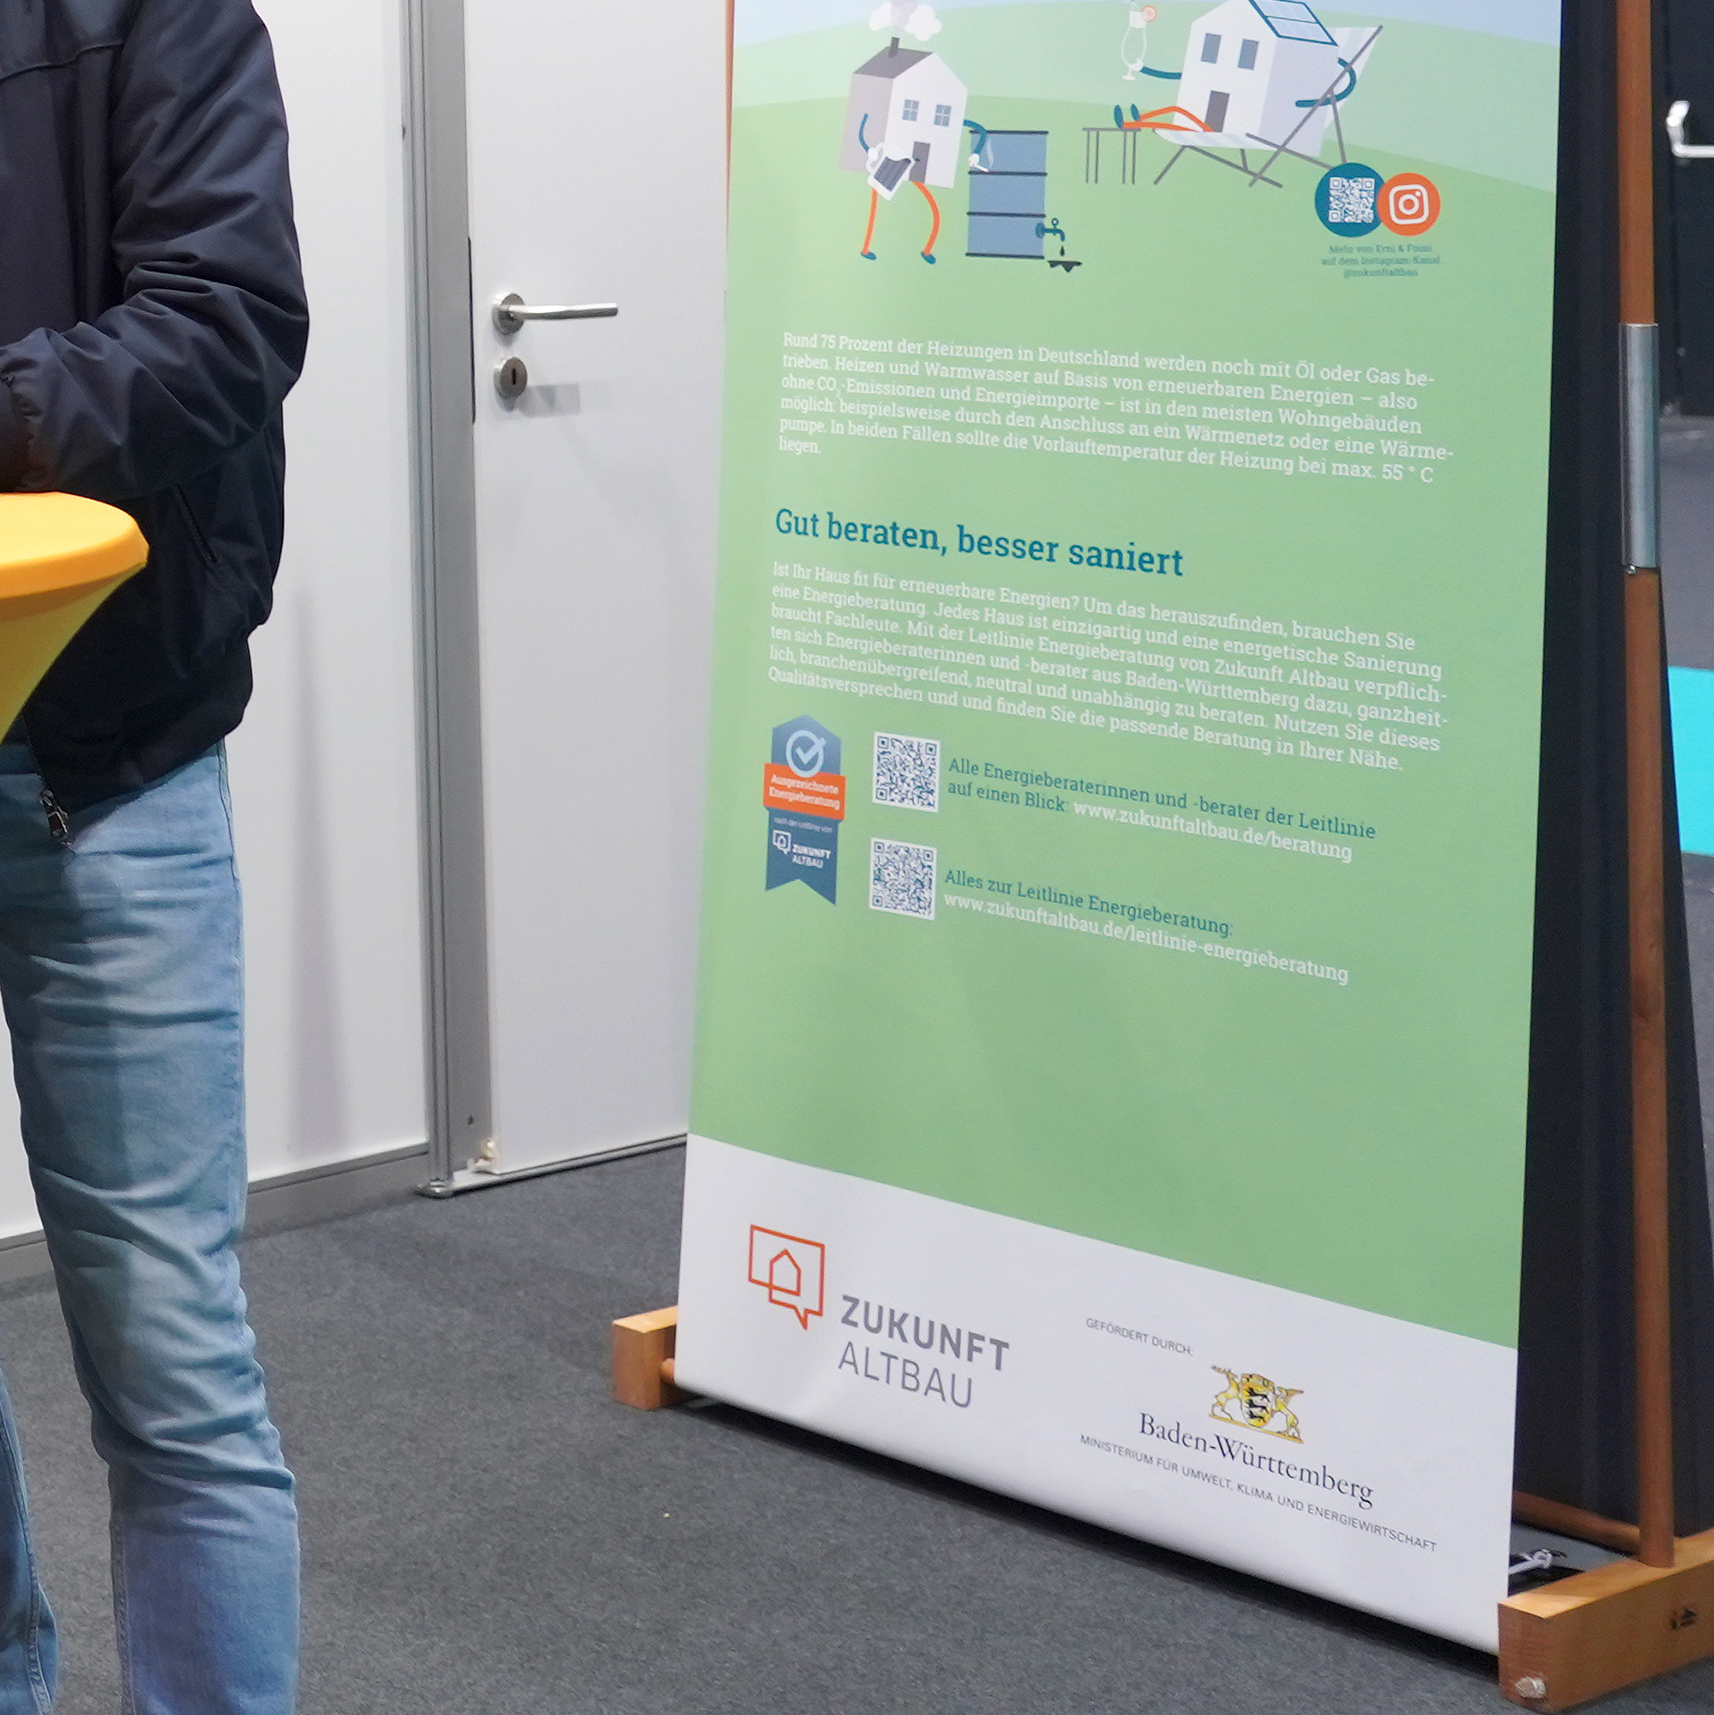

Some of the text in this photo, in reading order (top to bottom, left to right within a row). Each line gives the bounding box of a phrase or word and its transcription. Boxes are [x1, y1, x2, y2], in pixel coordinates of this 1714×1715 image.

[775, 508, 1183, 576] Gut beraten, besser saniert
[794, 630, 823, 645] sich
[825, 633, 986, 666] Energieberaterinnen
[989, 656, 1020, 671] und
[1092, 669, 1121, 684] aus
[1125, 672, 1299, 711] Baden-Württemberg
[947, 782, 973, 797] auf
[976, 787, 1020, 805] einen
[948, 758, 979, 776] Alle
[984, 763, 1150, 802] Energieberaterinnen
[1155, 793, 1187, 809] und
[1265, 807, 1294, 826] der
[1299, 812, 1376, 839] Leitlinie
[944, 870, 983, 889] Alles
[987, 880, 1013, 895] zur
[1017, 882, 1084, 908] Leitlinie
[841, 1296, 1010, 1369] ZUKUNFT
[1085, 1318, 1149, 1342] GEFÖRDERT
[838, 1344, 972, 1407] ALTBAU
[1080, 1435, 1153, 1464] MINISTERIUM
[1156, 1458, 1178, 1473] FÜR
[1237, 1483, 1274, 1502] KLIMA
[1277, 1495, 1304, 1511] UND
[1307, 1504, 1437, 1551] ENERGIEWIRTSCHAFT
[1139, 1414, 1374, 1506] Baden-Württemberg
